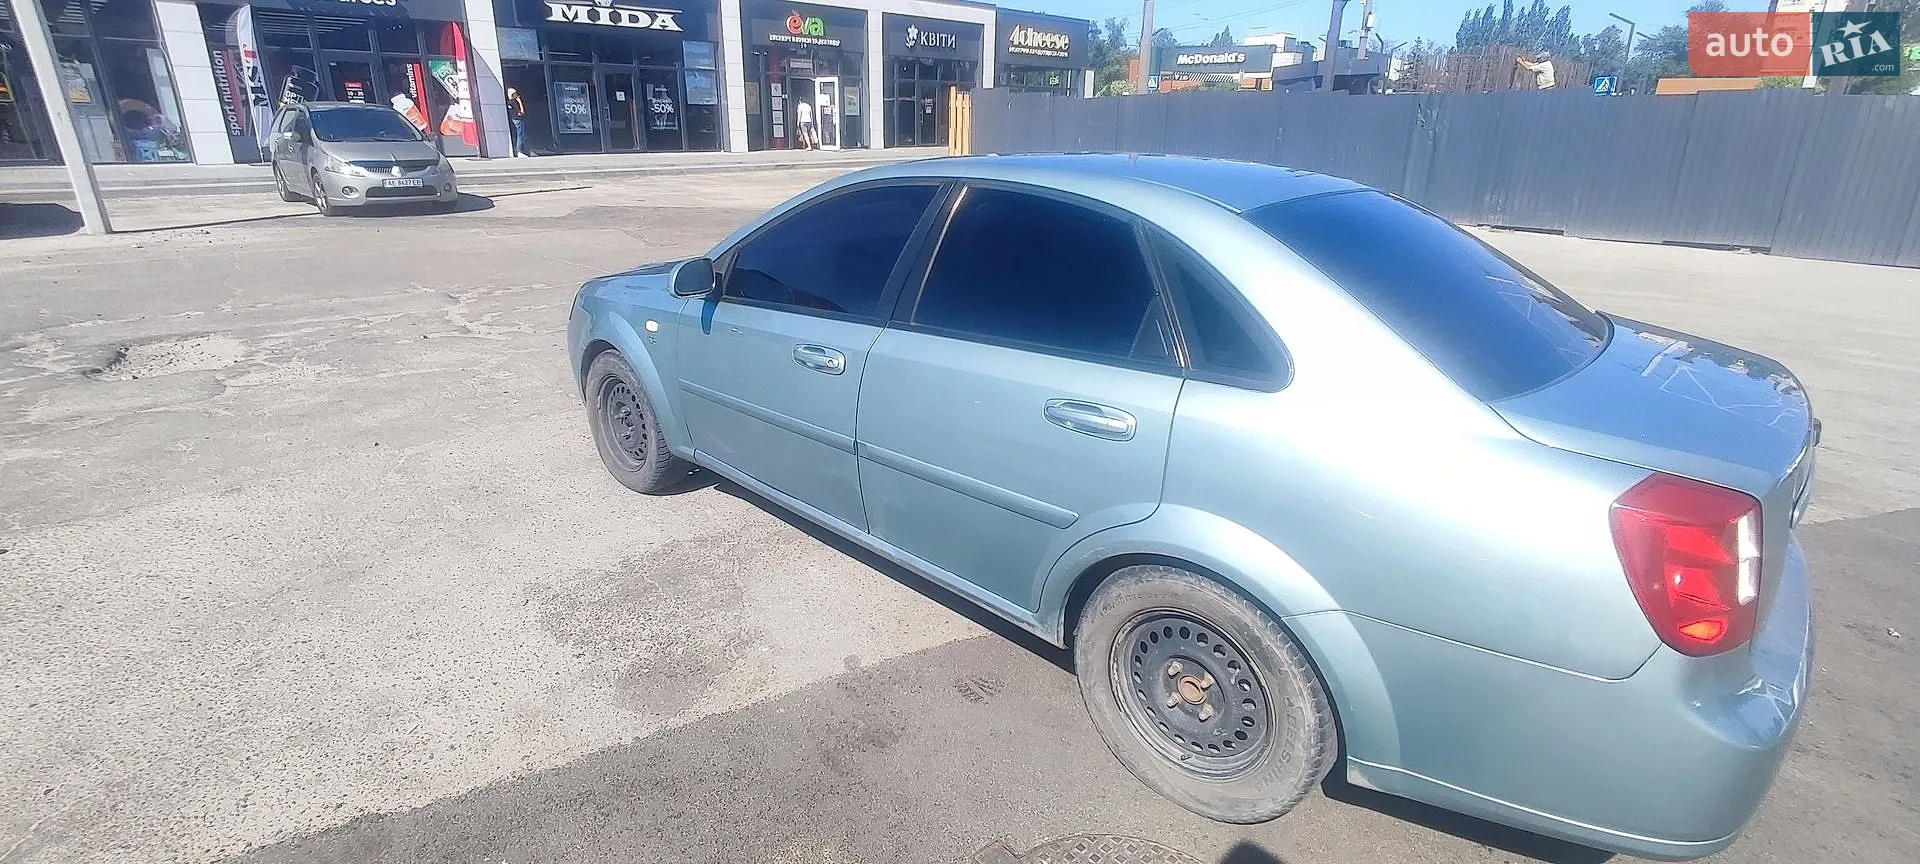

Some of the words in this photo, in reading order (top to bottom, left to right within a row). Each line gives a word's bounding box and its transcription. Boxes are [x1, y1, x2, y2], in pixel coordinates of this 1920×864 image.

[545, 3, 684, 31] MIDA
[786, 14, 825, 36] eva
[920, 31, 957, 49] КВІТИ
[1009, 24, 1070, 50] 4cheese
[1176, 52, 1246, 65] McDonald's
[213, 50, 233, 102] nutrition
[406, 63, 418, 98] vitamins
[224, 104, 242, 136] sport
[562, 104, 587, 114] -50%
[650, 103, 675, 114] -50%
